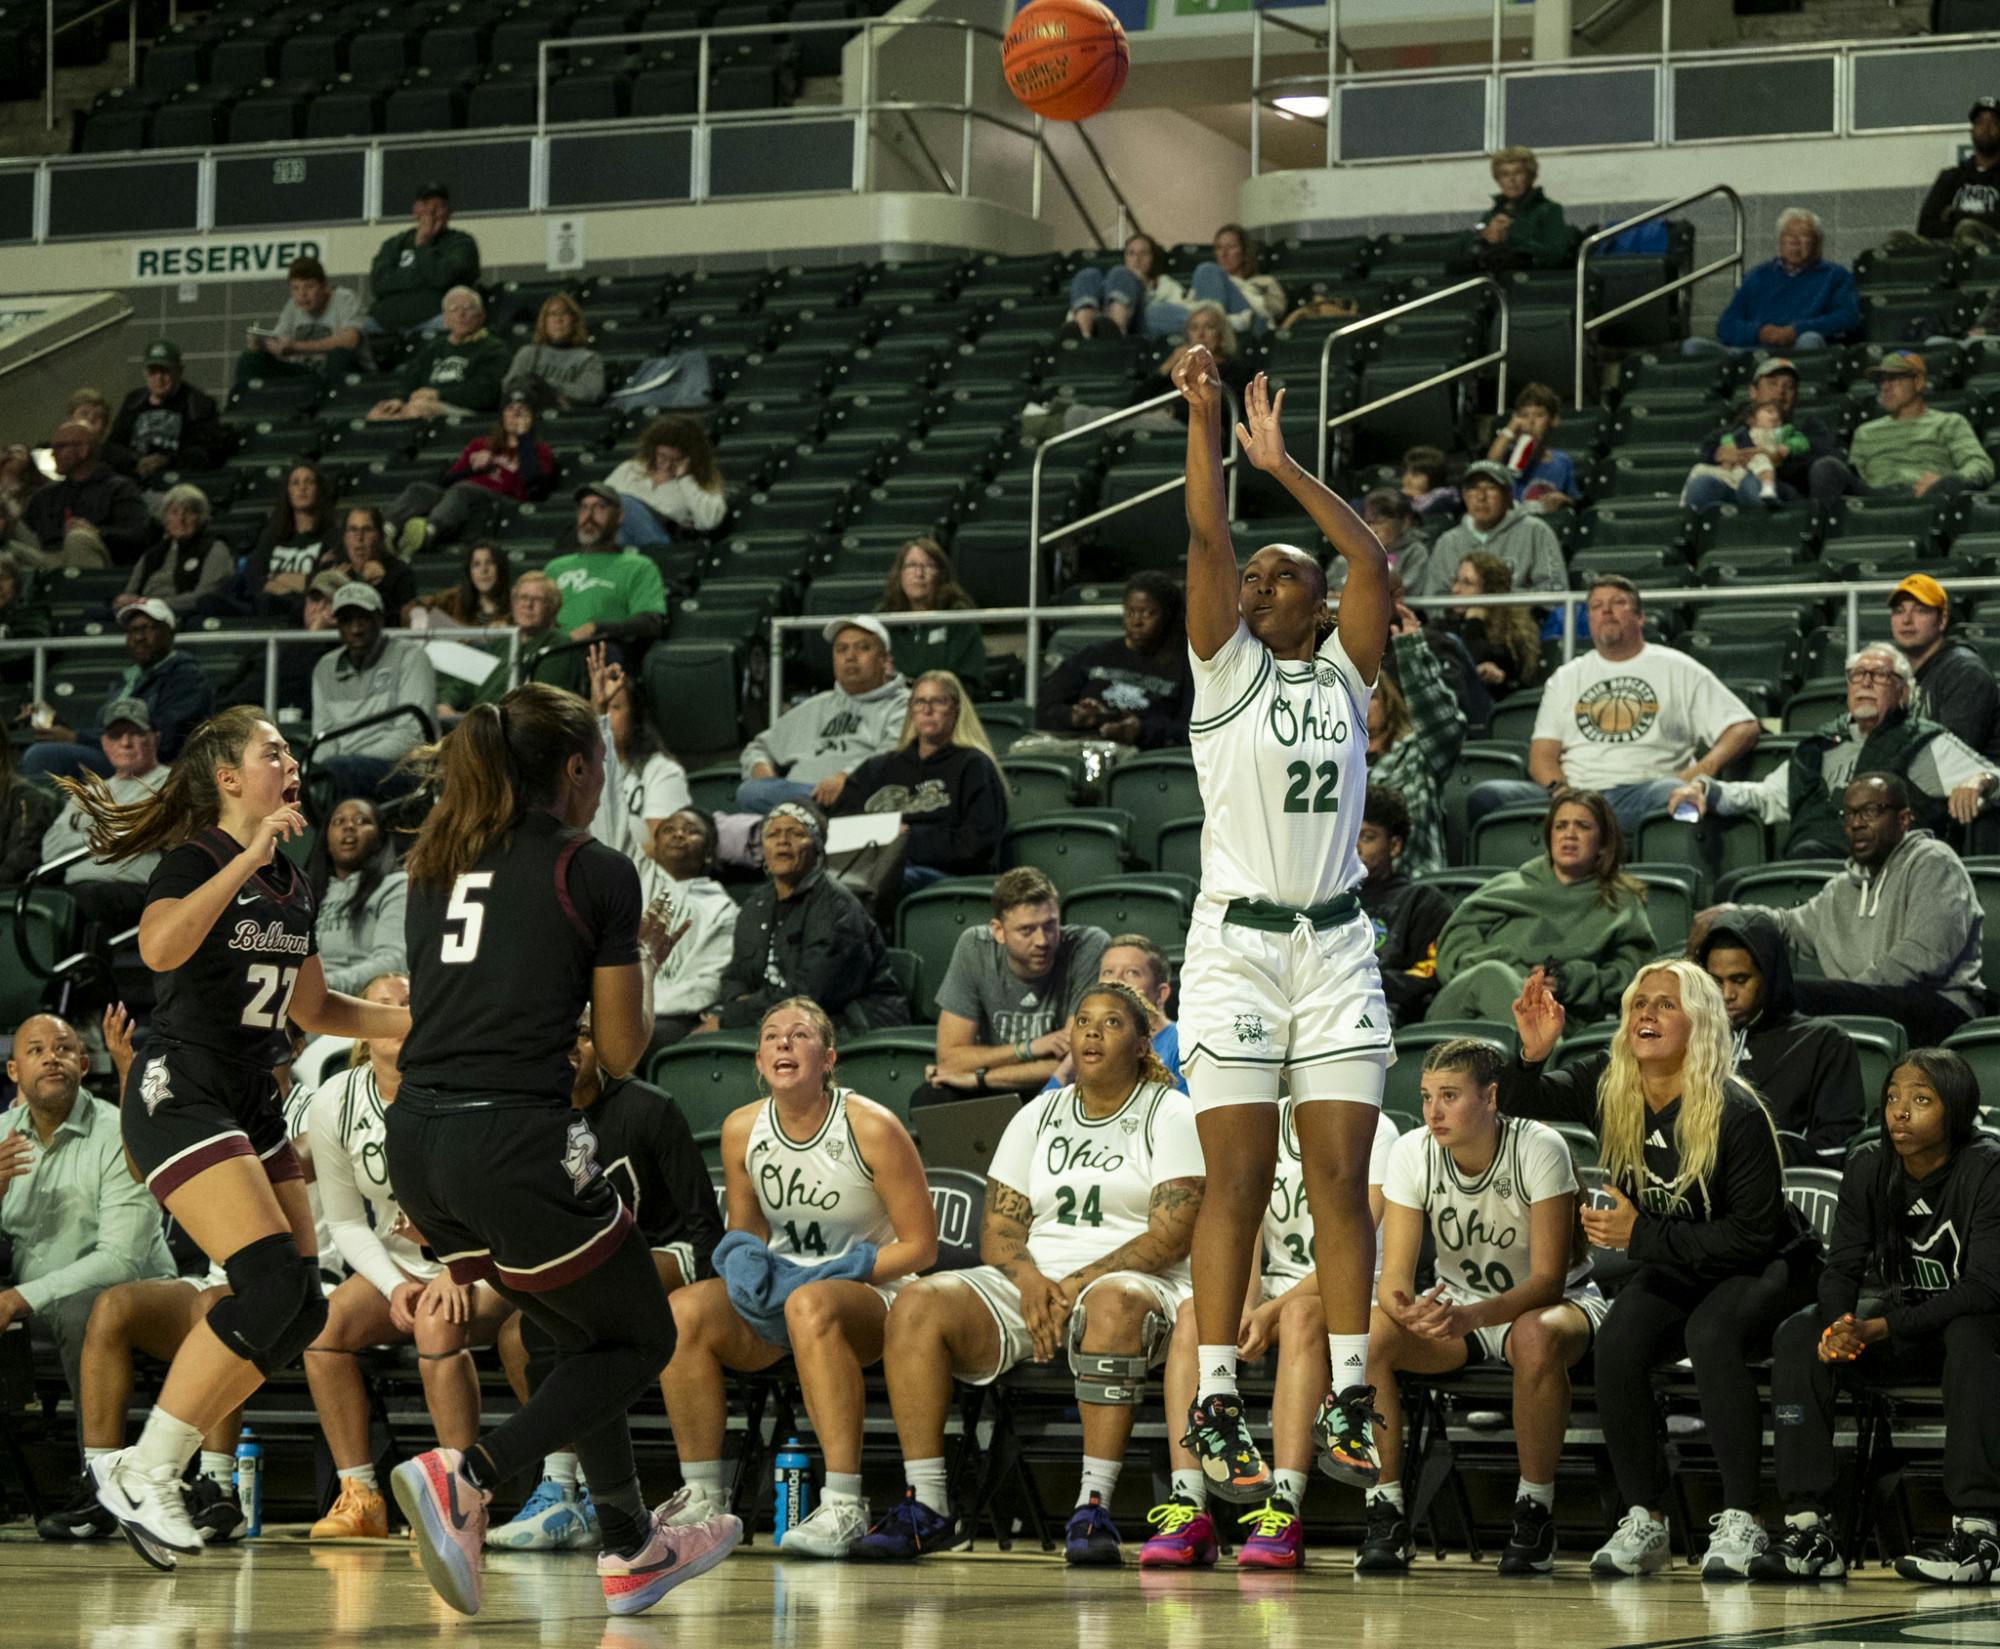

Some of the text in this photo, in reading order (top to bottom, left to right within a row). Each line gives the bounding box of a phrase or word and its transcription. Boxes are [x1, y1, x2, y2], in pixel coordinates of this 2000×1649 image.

[138, 241, 320, 276] RESERVED
[1270, 695, 1348, 747] Ohio
[1283, 760, 1340, 813] 22
[440, 871, 495, 964] 5
[1047, 1136, 1124, 1175] Ohio
[760, 1163, 841, 1211] Ohio
[1054, 1184, 1104, 1227] 24
[783, 1219, 828, 1257] 14
[1282, 1232, 1316, 1266] 3
[1437, 1206, 1517, 1251] Ohio
[1459, 1258, 1515, 1294] 20
[787, 1468, 800, 1530] POWERAD
